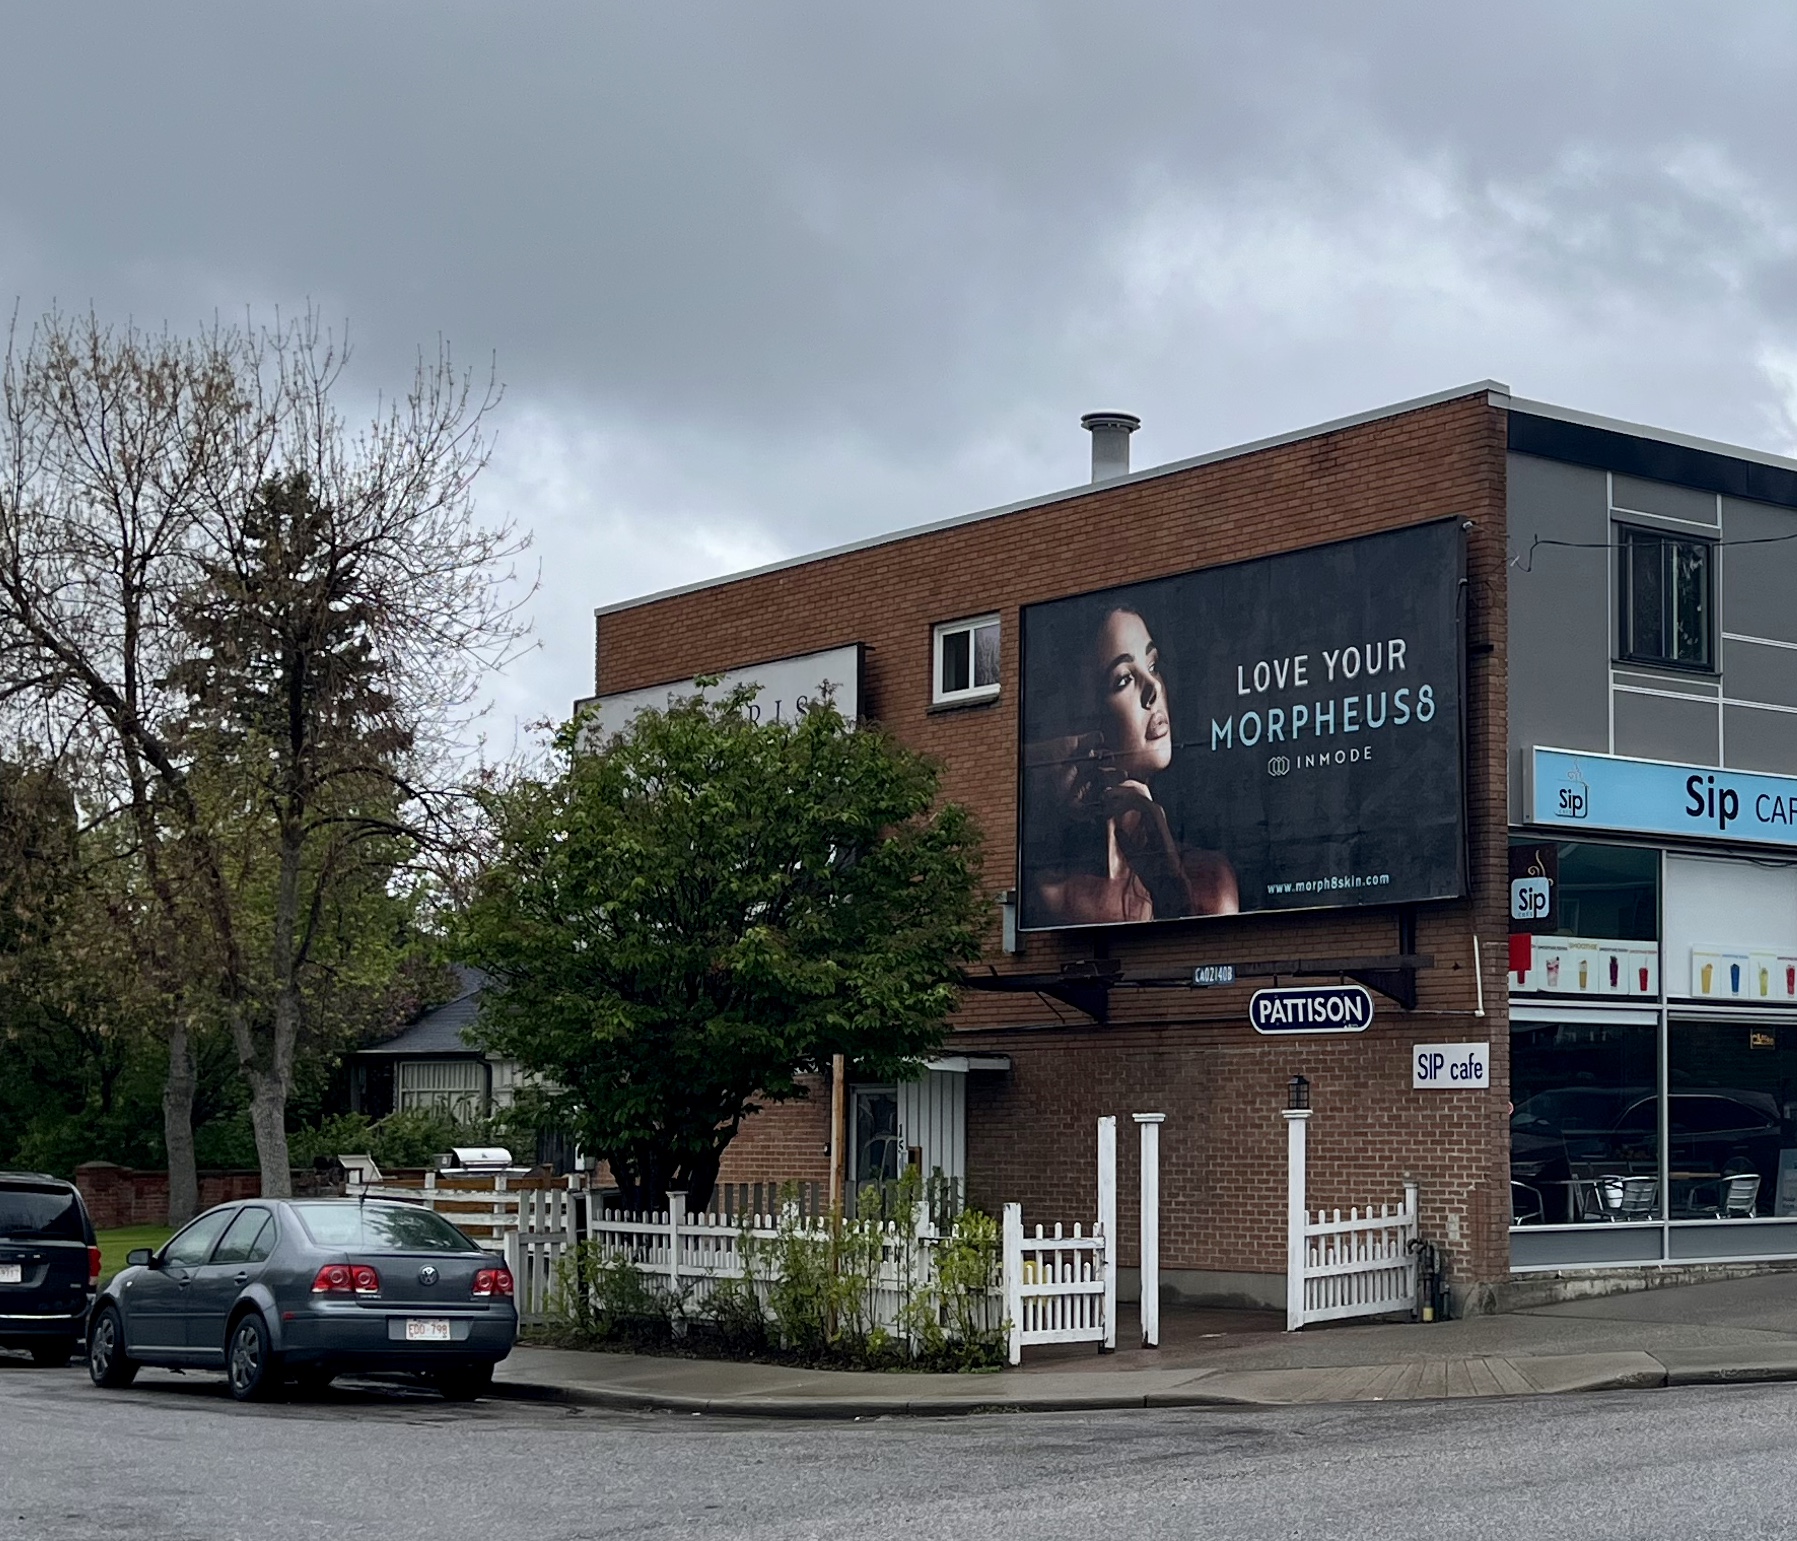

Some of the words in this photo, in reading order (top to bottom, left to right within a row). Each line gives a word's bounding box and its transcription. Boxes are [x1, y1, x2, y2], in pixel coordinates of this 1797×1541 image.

[1237, 654, 1309, 696] LOVE
[1322, 638, 1406, 683] YOUR
[1211, 684, 1435, 751] MORPHEUS8
[1296, 746, 1372, 769] INMODE
[1559, 788, 1583, 817] Sip
[1685, 774, 1739, 830] Sip
[1267, 874, 1390, 894] www.morph8skin.com
[1518, 887, 1546, 918] Sip
[1259, 996, 1363, 1023] PATTISON
[1418, 1053, 1445, 1080] SIP
[1450, 1052, 1483, 1080] cafe
